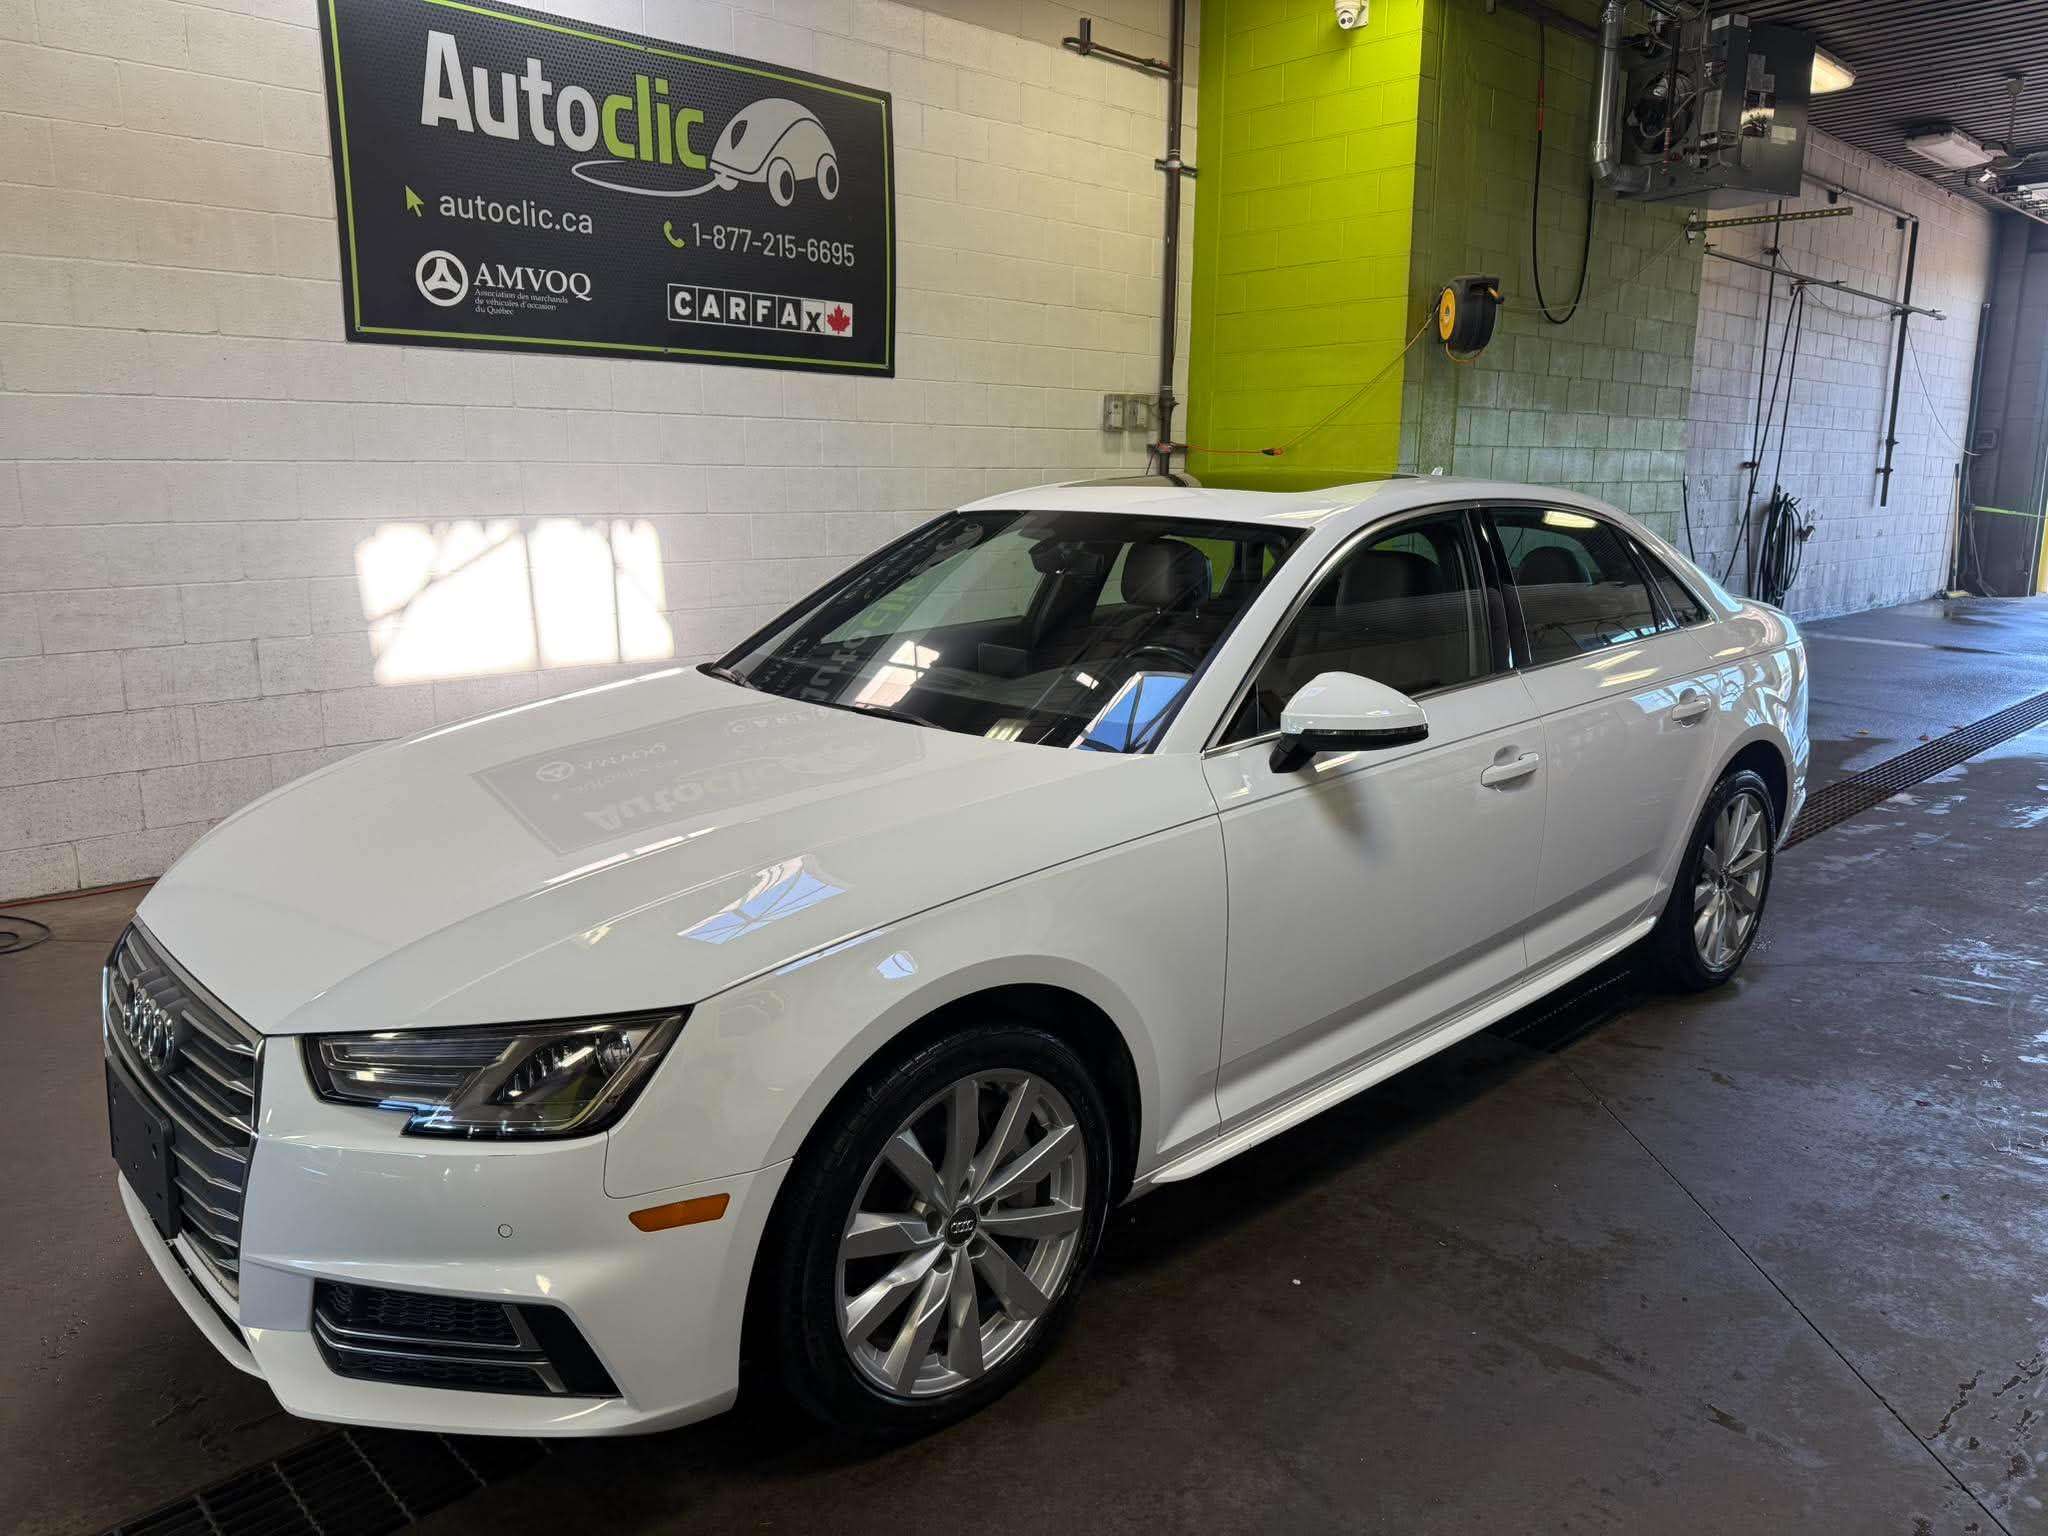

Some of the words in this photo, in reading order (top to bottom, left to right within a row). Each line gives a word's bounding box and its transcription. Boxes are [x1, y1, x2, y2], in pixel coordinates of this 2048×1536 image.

[421, 30, 707, 169] Autoclic
[439, 195, 594, 234] autoclic.ca
[692, 222, 855, 267] 1-877-215-6695
[473, 262, 592, 301] AMVOQ
[474, 288, 515, 299] Association
[517, 293, 531, 301] des
[531, 294, 568, 304] marchands
[475, 297, 484, 305] de
[674, 291, 821, 333] CARFAX
